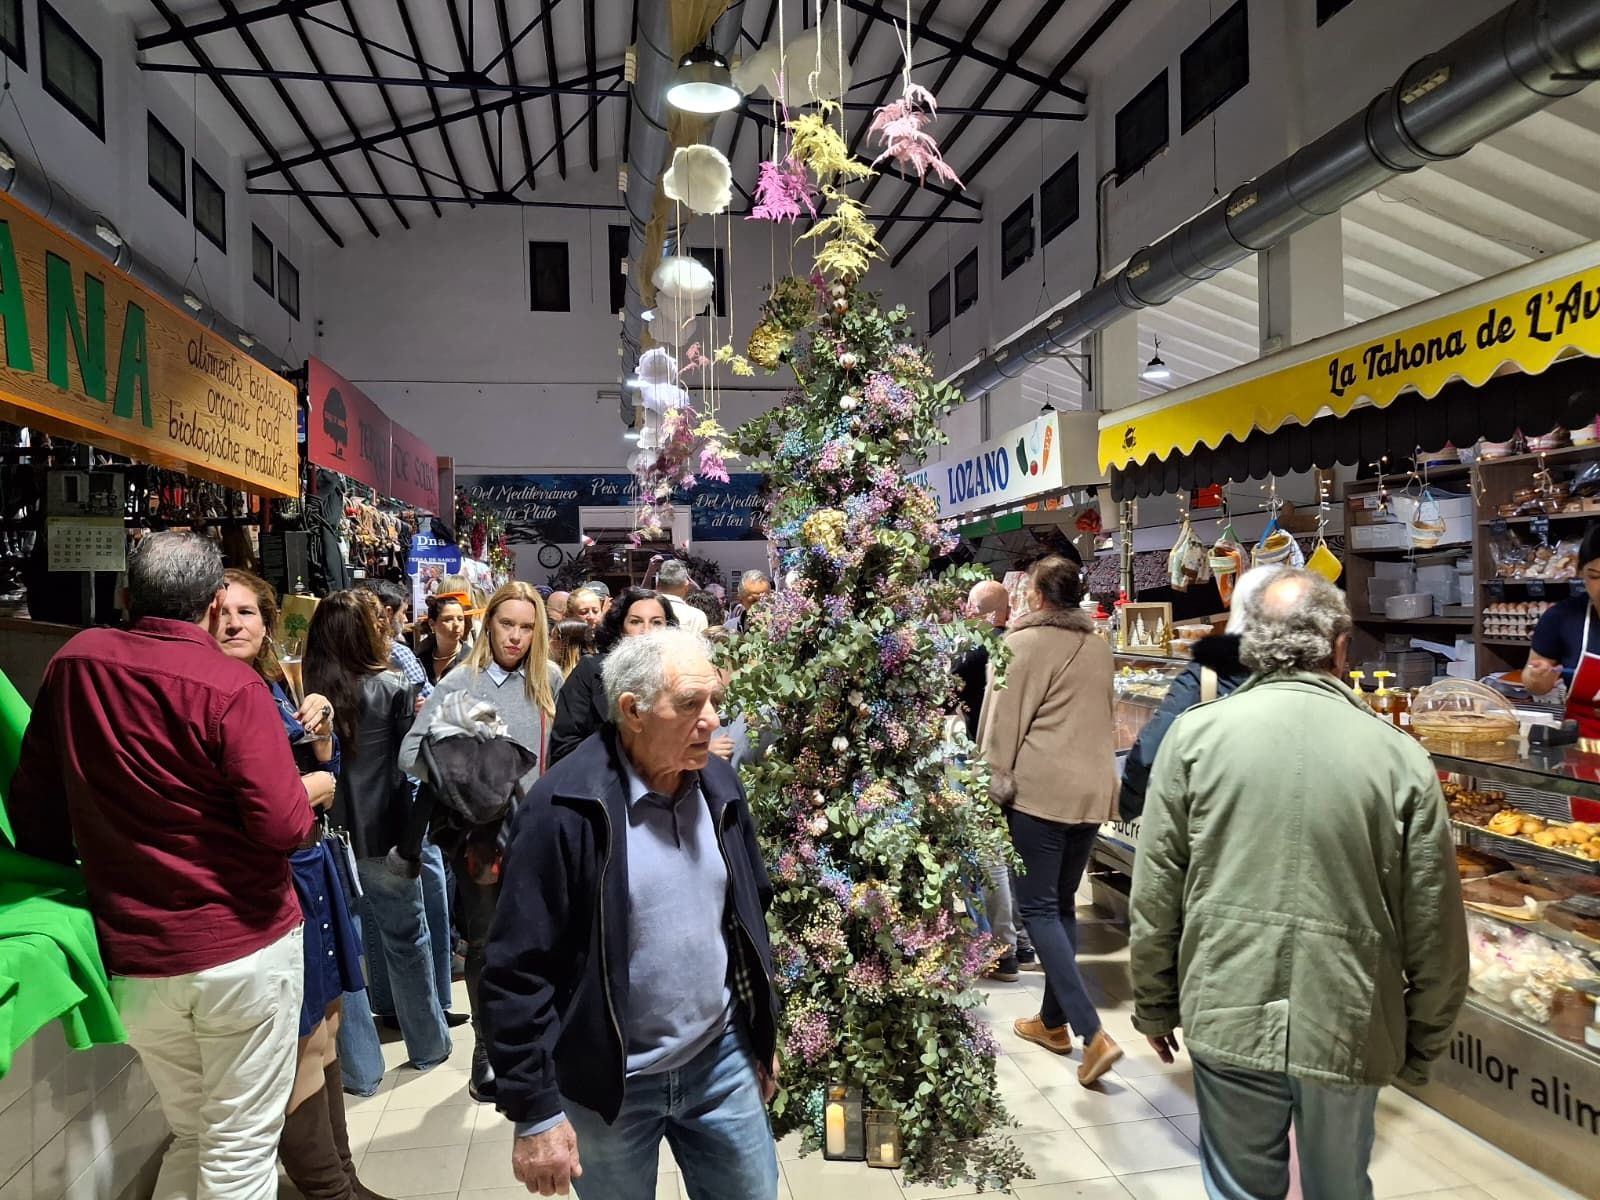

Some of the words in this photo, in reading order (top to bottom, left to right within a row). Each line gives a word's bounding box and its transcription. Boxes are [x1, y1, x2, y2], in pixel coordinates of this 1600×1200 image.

[1328, 357, 1356, 397] La
[1363, 329, 1467, 380] Tahona
[1476, 308, 1516, 350] de
[1525, 280, 1600, 342] L'Av
[187, 332, 242, 391] aliments
[207, 388, 251, 432] organic
[256, 405, 281, 445] food
[168, 400, 240, 464] biologische
[244, 444, 288, 482] produkte
[471, 485, 495, 500] Del
[591, 477, 619, 496] Peix
[947, 446, 1009, 505] LOZANO
[518, 502, 557, 521] Plato
[695, 493, 719, 508] Del
[721, 492, 766, 511] Mediter
[712, 513, 724, 527] al
[749, 510, 769, 528] Pla
